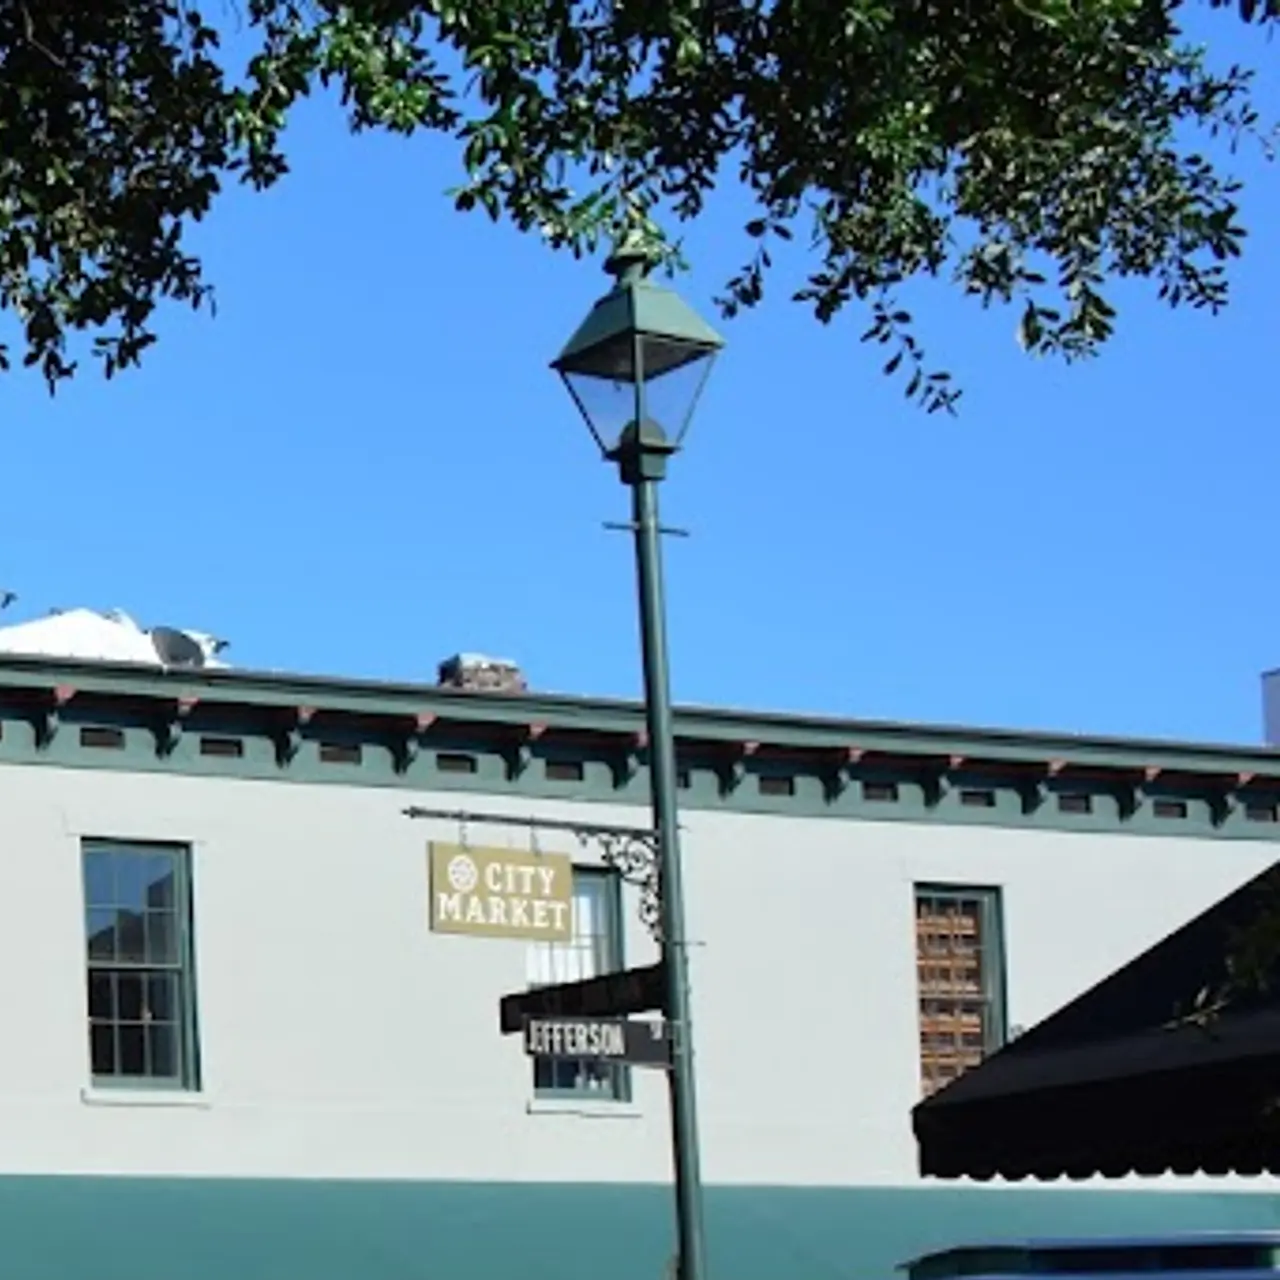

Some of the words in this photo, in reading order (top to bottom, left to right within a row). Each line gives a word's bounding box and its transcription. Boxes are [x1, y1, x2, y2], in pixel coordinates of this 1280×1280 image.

[485, 862, 555, 894] CITY
[438, 894, 568, 930] MARKET
[529, 1018, 626, 1056] JEFFERSON
